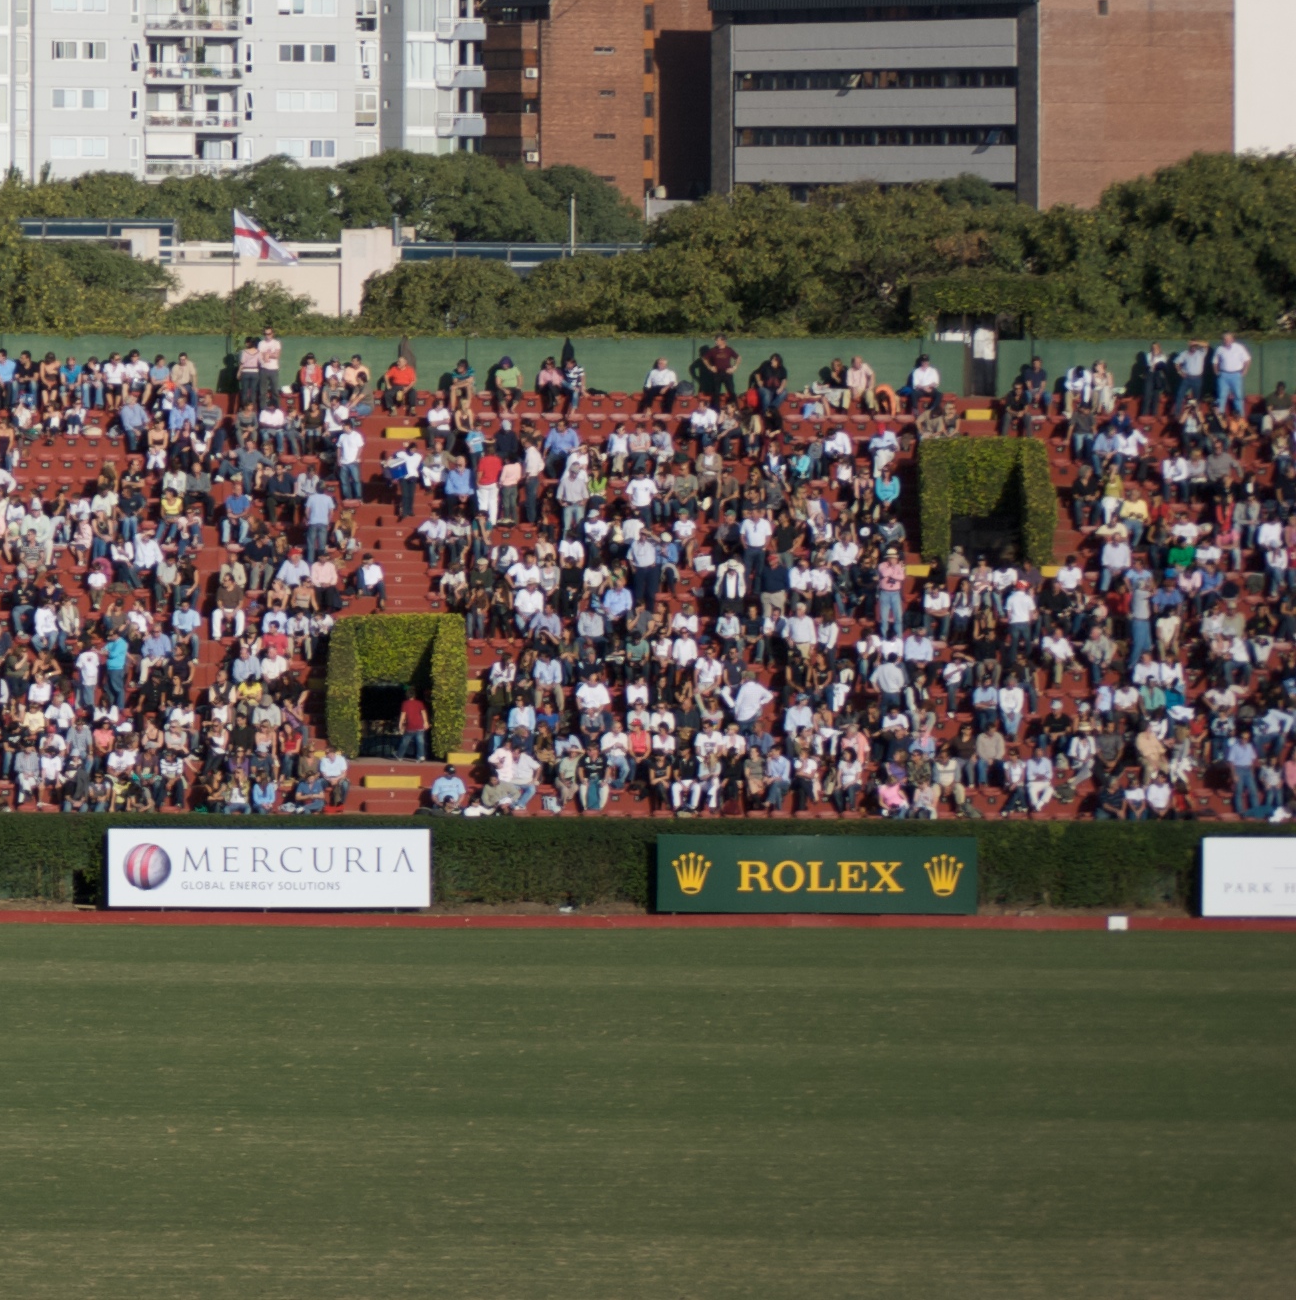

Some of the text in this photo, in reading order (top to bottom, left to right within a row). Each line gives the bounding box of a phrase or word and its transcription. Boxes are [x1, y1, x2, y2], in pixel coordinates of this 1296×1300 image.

[181, 846, 415, 873] MERCURIA
[181, 881, 341, 891] GLOBAL ENERGY SOLUTIONS
[737, 860, 904, 893] ROLEX
[1223, 882, 1273, 894] PARK
